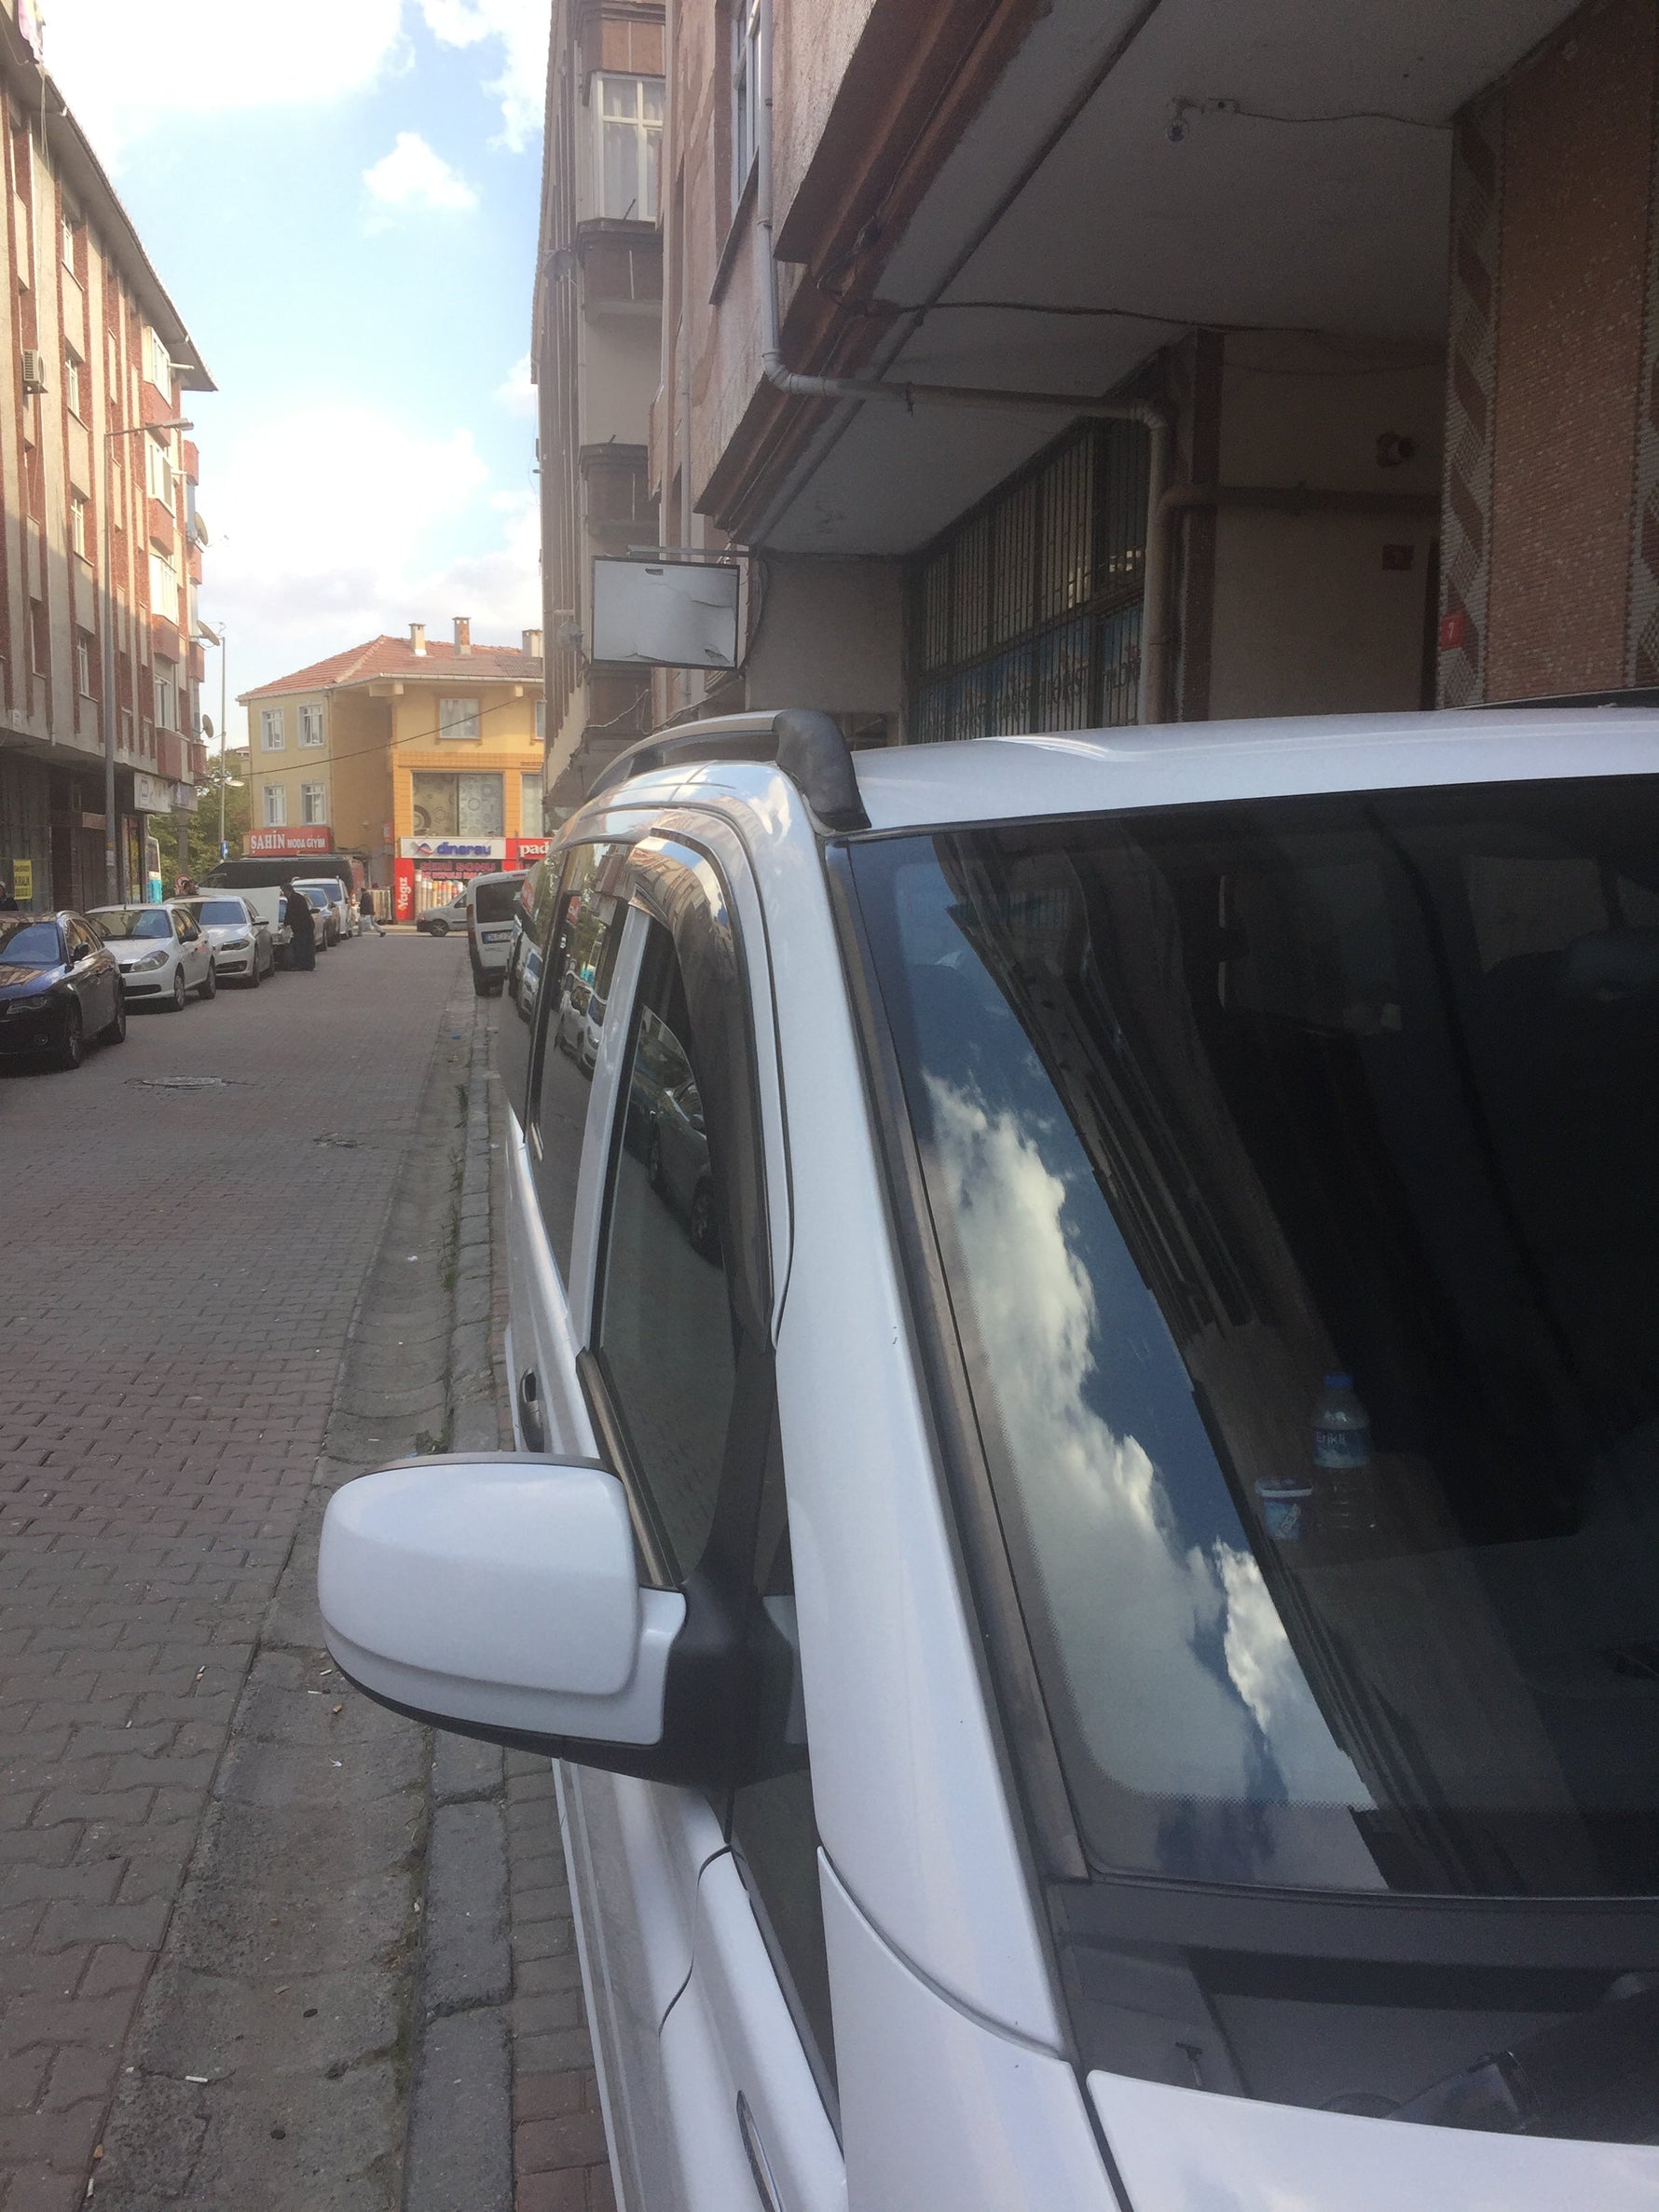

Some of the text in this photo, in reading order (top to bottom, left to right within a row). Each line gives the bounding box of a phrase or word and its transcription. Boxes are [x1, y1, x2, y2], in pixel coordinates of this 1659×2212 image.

[1447, 622, 1455, 640] 7
[251, 831, 326, 854] ŞAHİN MODA GİYİM
